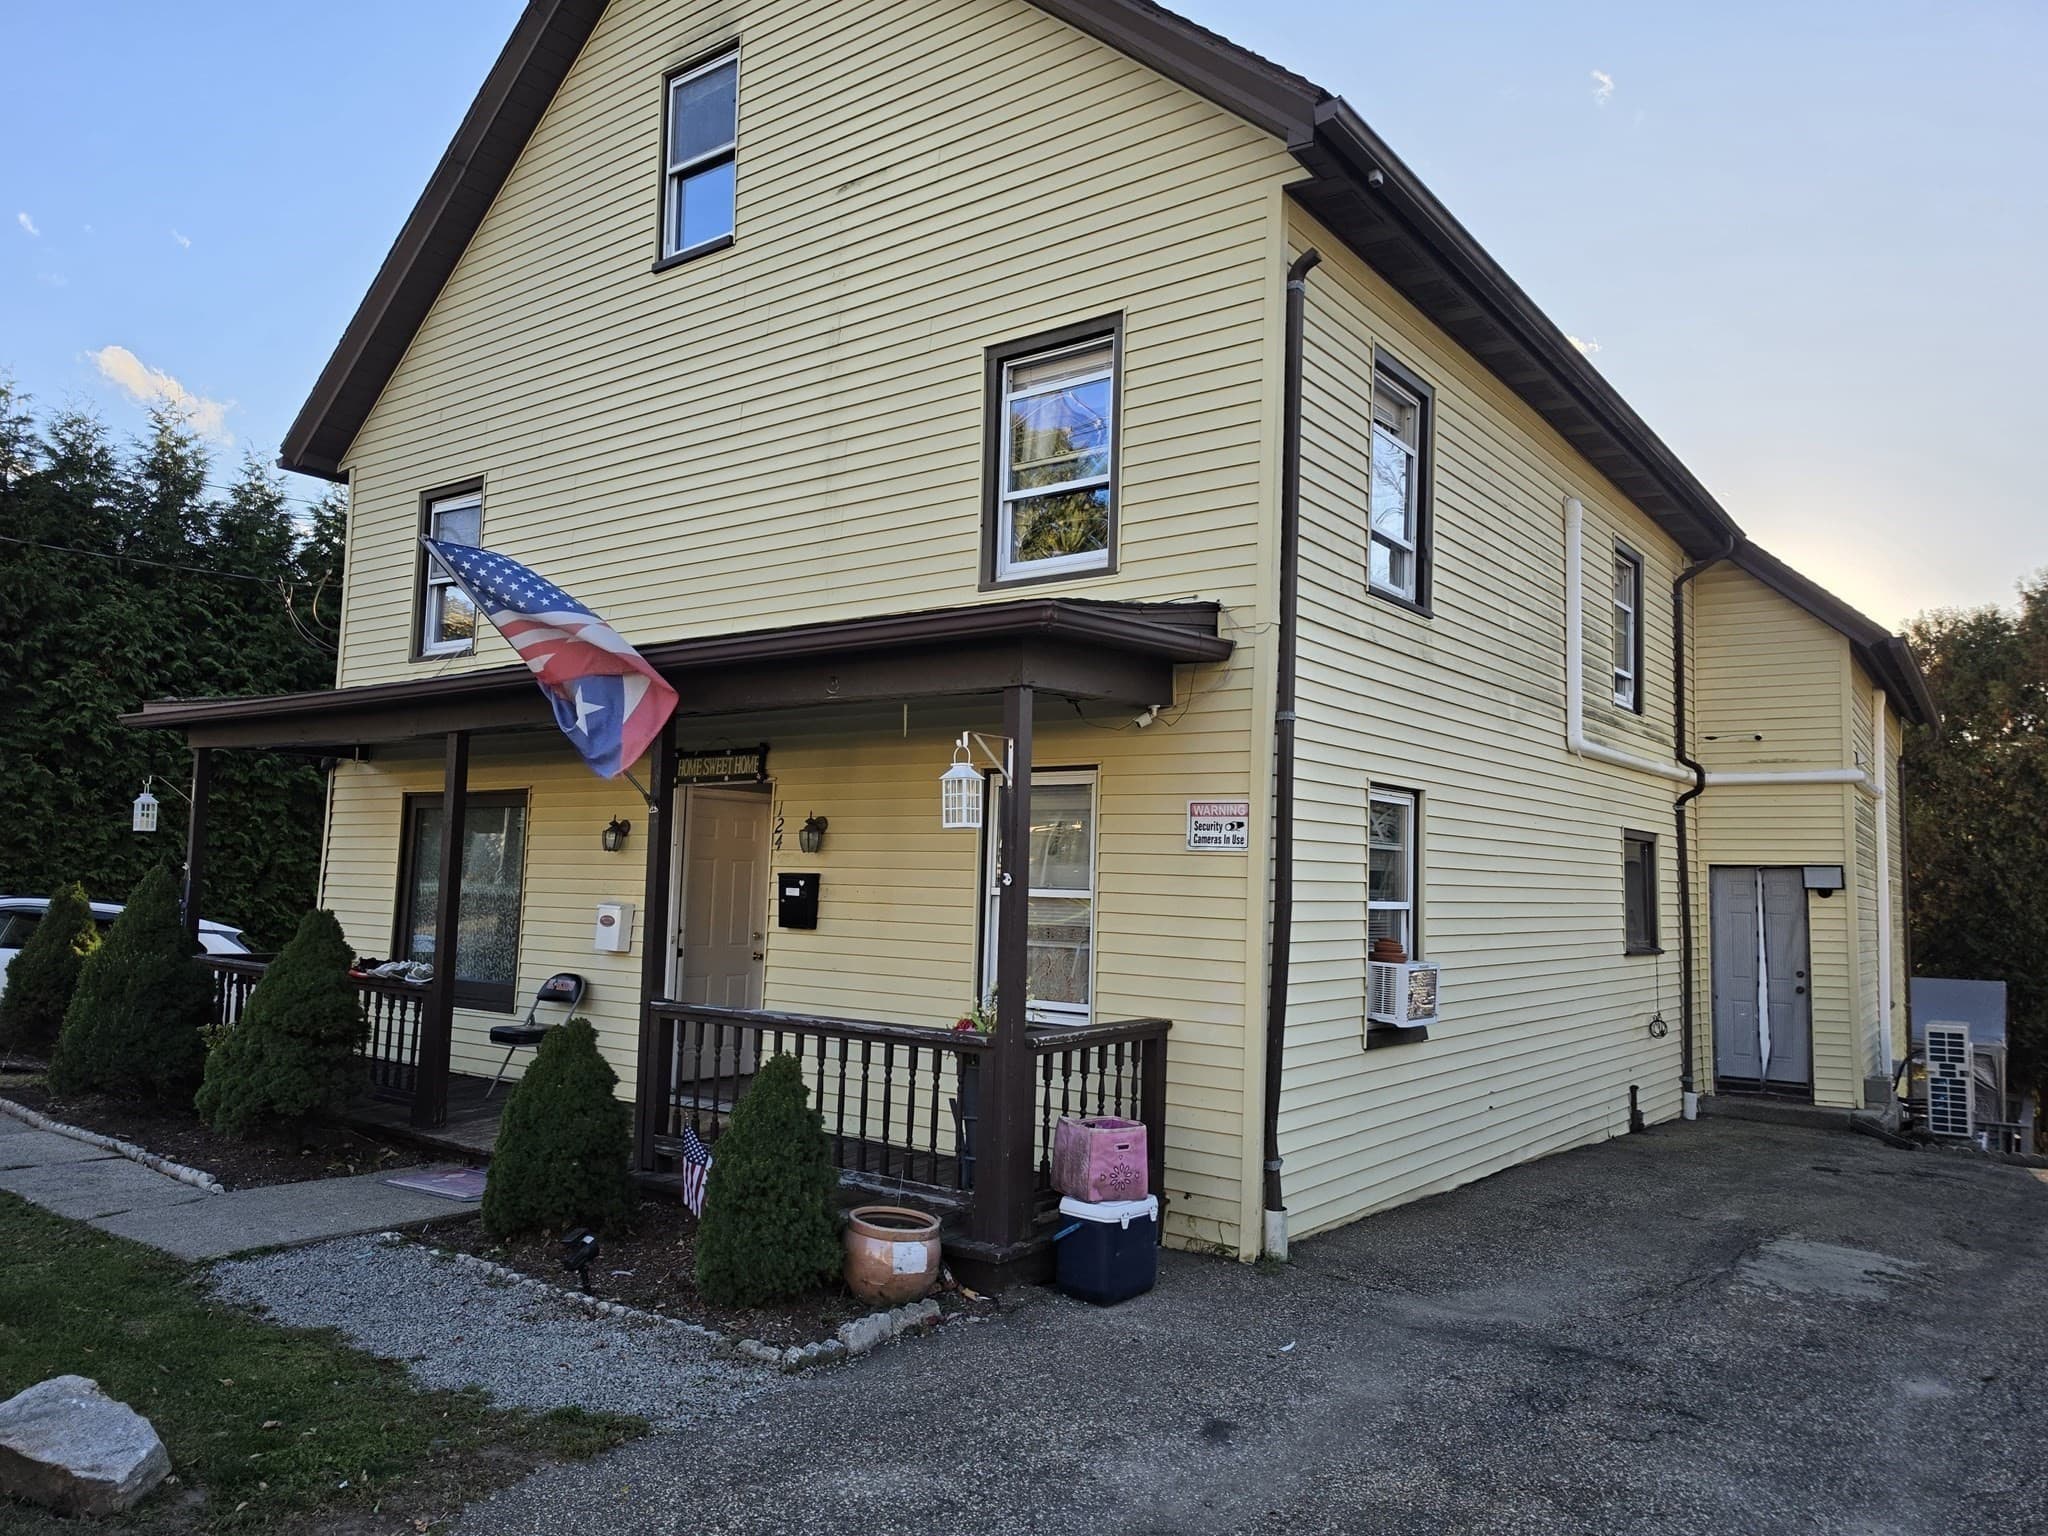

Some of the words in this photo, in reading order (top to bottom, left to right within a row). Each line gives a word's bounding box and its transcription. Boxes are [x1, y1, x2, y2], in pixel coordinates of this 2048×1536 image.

[678, 759, 702, 776] HOME
[703, 757, 733, 775] SWEET
[734, 755, 759, 773] HOME
[1193, 805, 1246, 816] WARNING
[774, 800, 785, 851] 124
[1194, 821, 1223, 833] Security
[1194, 833, 1222, 844] Cameras
[1224, 834, 1231, 844] In
[1232, 834, 1244, 844] Use
